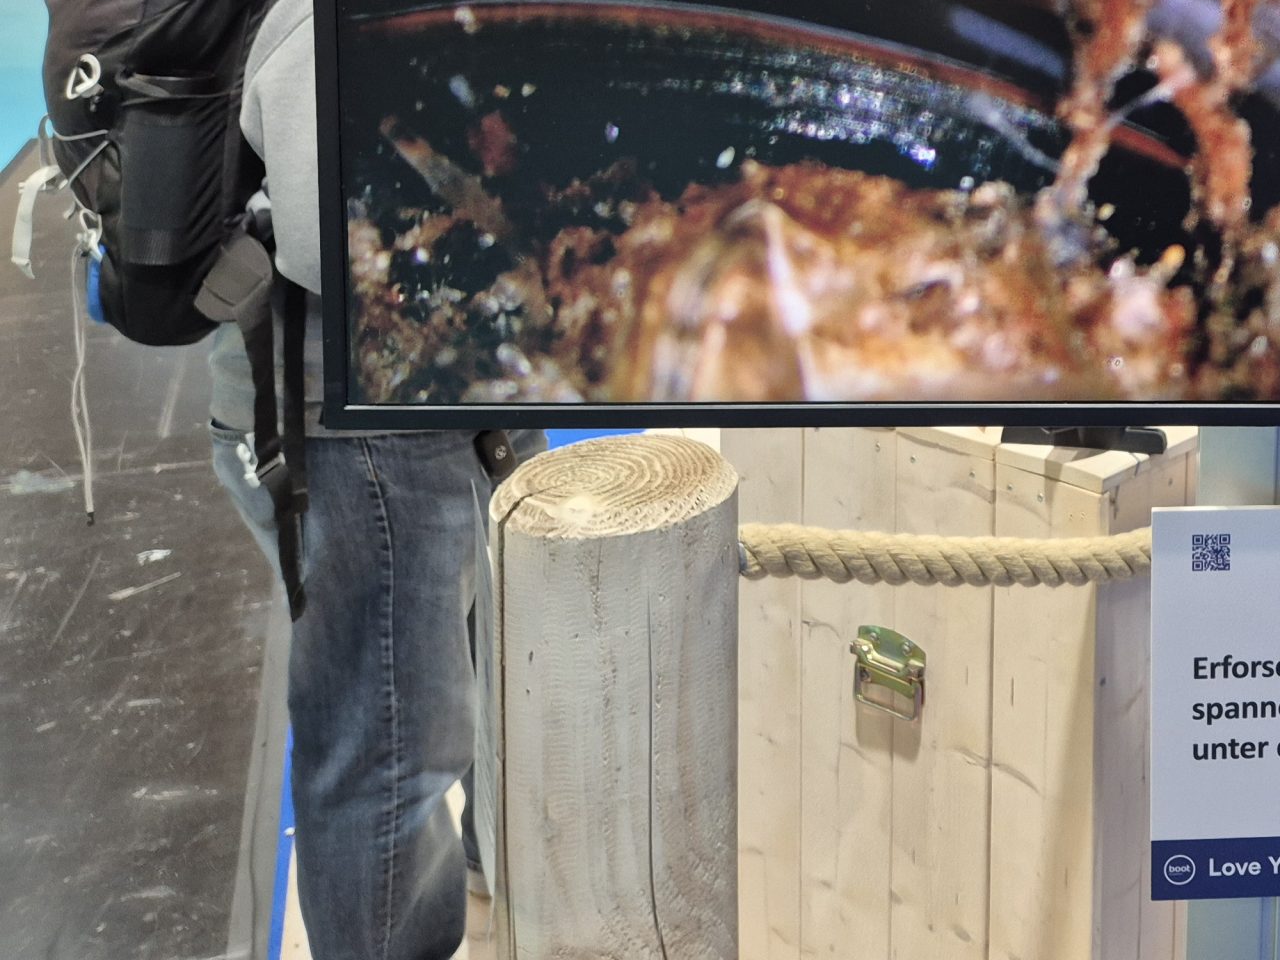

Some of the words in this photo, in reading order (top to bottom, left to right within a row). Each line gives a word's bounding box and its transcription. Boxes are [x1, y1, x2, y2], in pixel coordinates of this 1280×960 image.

[1192, 738, 1269, 761] unter
[1169, 865, 1191, 873] boot
[1208, 857, 1262, 877] Love
